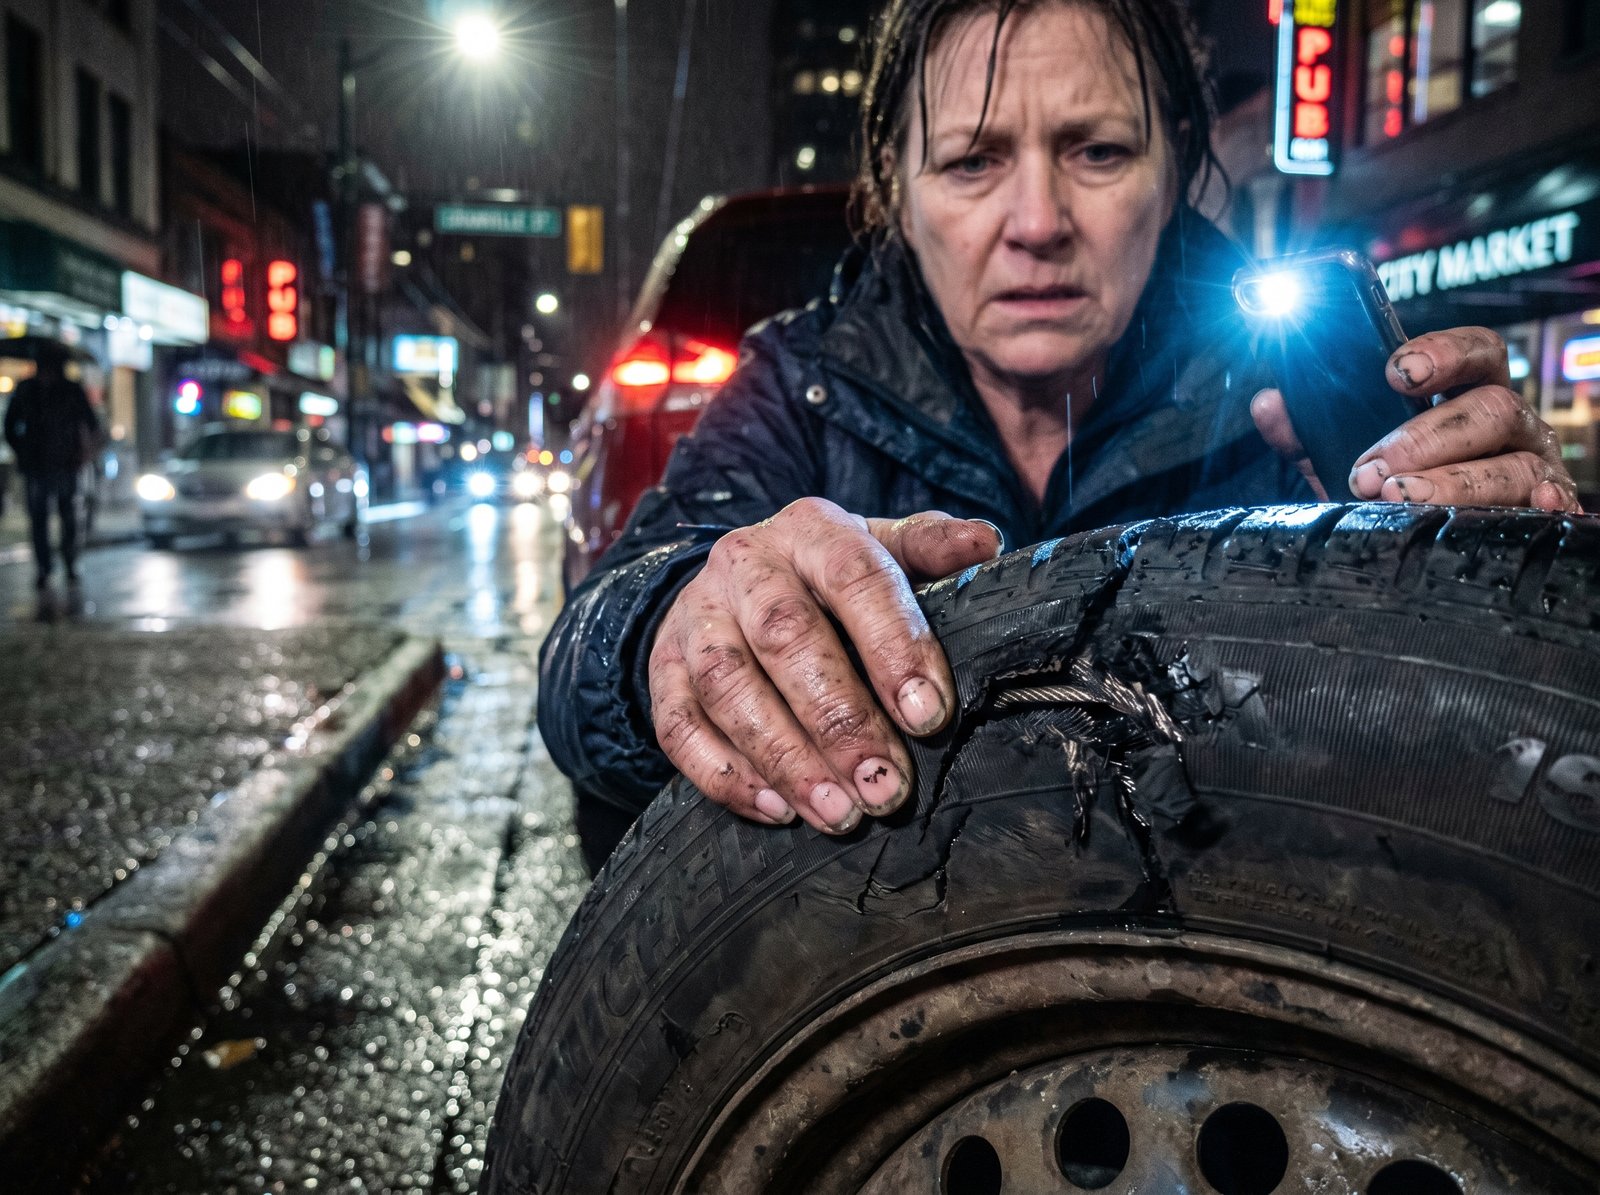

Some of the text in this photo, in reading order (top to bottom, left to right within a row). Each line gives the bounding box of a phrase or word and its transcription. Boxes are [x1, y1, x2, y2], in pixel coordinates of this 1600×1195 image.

[1295, 27, 1332, 138] PUB
[267, 260, 298, 340] PUB
[1377, 211, 1580, 303] CITY MARKET
